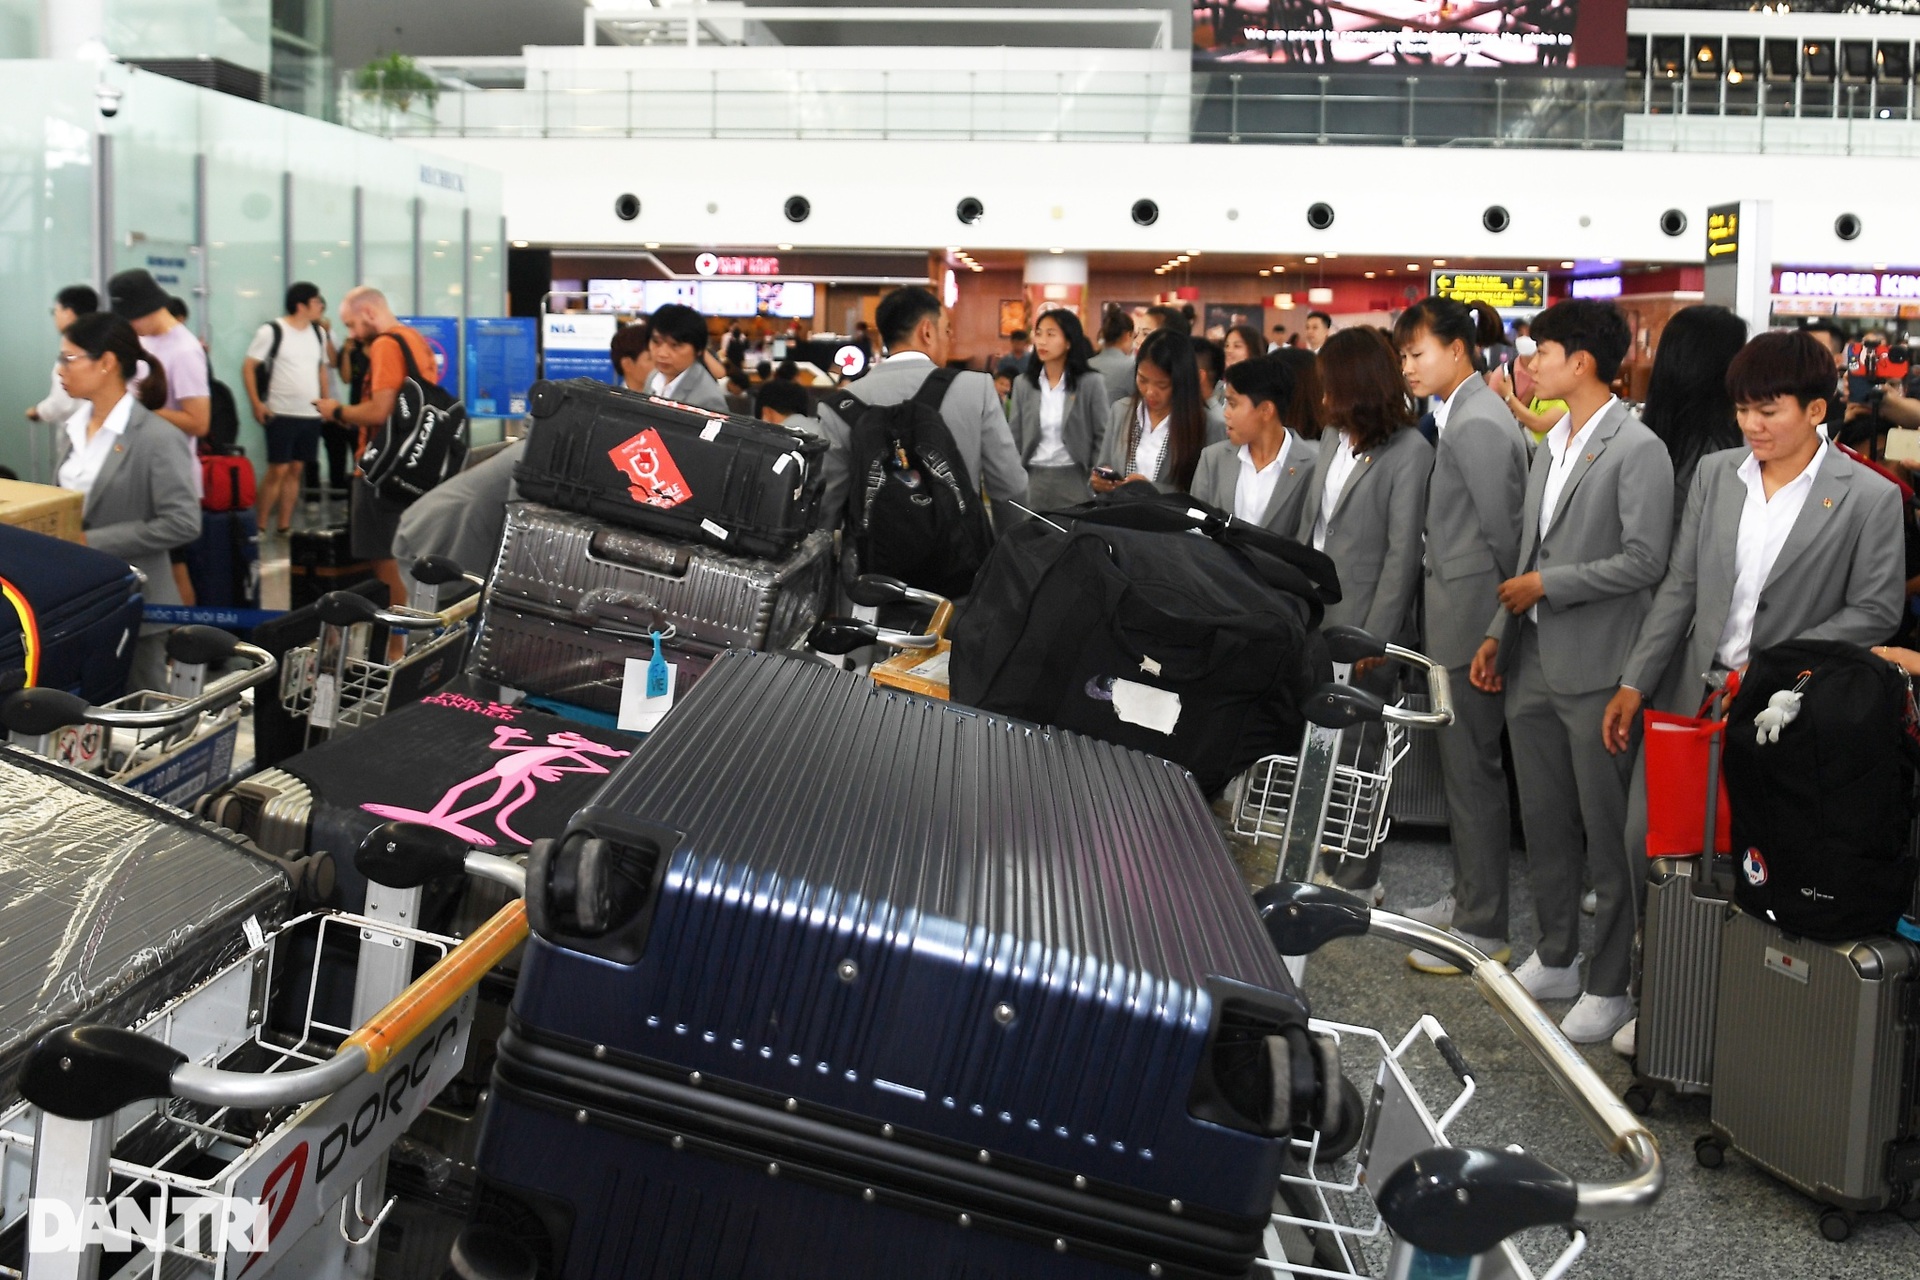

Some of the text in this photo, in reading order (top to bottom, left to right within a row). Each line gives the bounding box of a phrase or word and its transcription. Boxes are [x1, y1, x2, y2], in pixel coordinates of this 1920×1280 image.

[1780, 271, 1877, 295] BURGER
[550, 323, 576, 333] NIA
[406, 411, 435, 469] VULCAN
[420, 696, 515, 721] PANTHER
